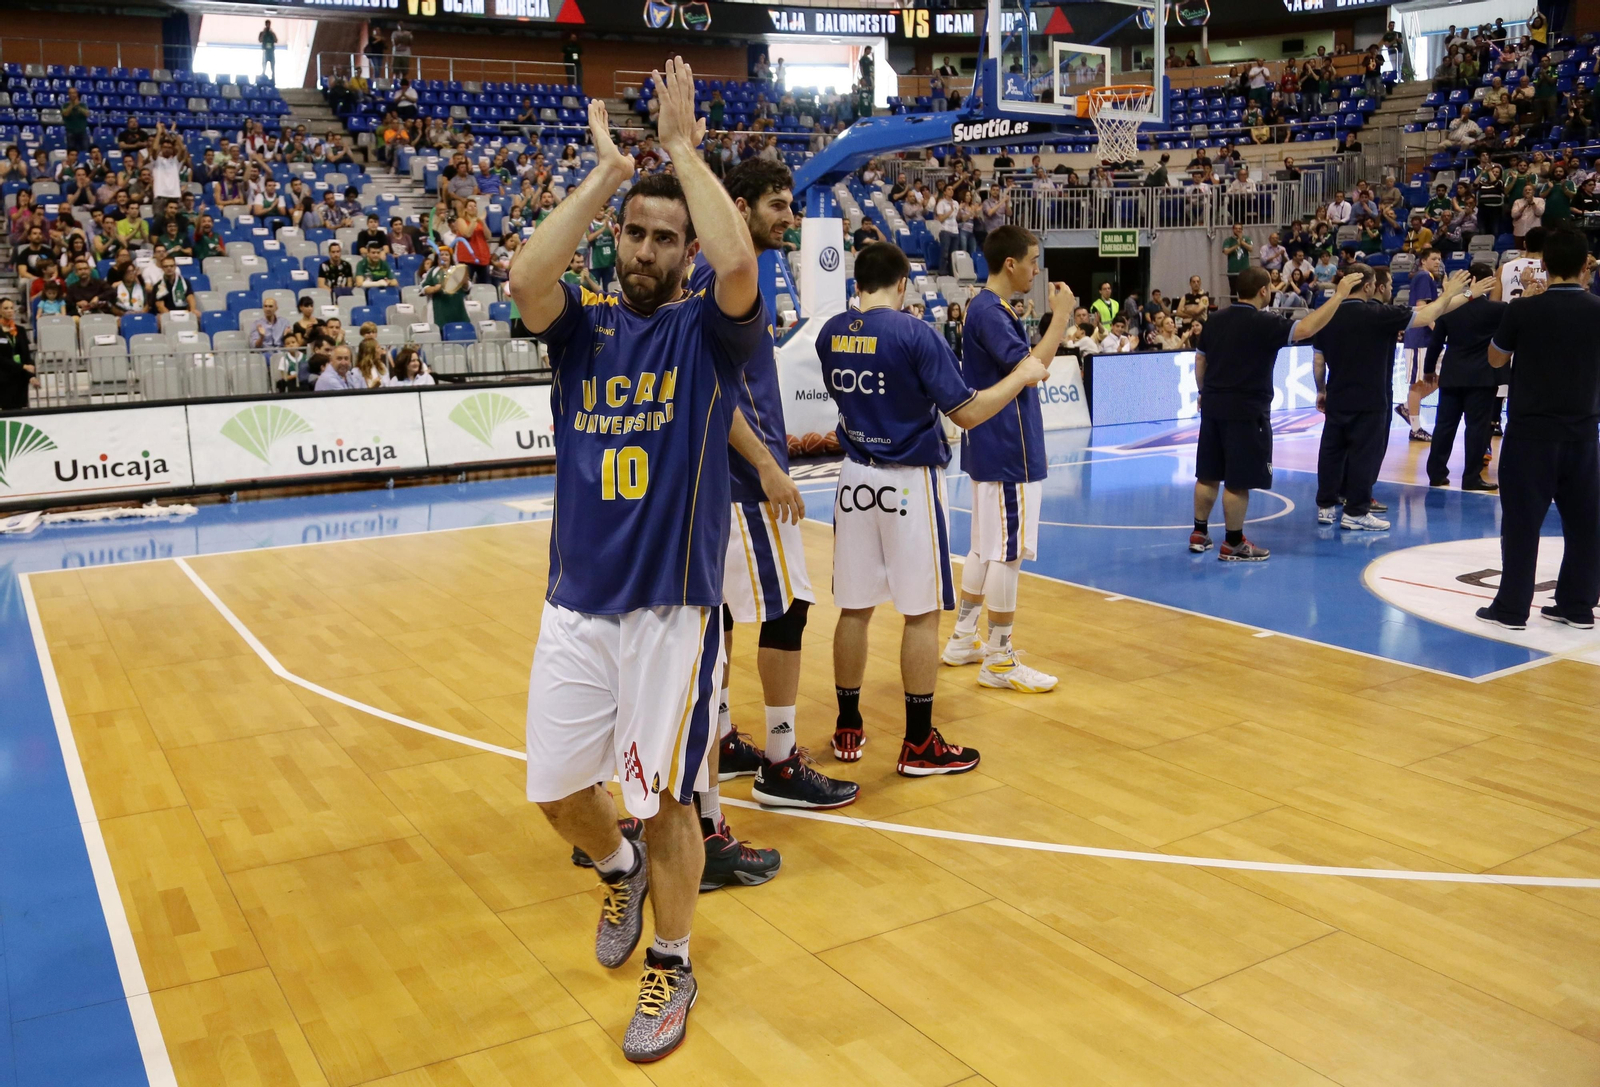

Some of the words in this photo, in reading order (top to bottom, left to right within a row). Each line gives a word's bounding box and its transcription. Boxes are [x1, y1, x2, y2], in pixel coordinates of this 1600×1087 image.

[443, 0, 485, 14] UCAM
[495, 0, 550, 18] MURCIA
[770, 11, 806, 31] CAJA
[815, 13, 897, 33] BALONCESTO
[901, 9, 930, 38] VS
[936, 13, 975, 33] UCAM
[953, 118, 1029, 143] Suertia.es
[1102, 243, 1135, 251] EMERGENCIA
[831, 335, 878, 354] MARTIN
[795, 388, 830, 402] Málag
[1038, 382, 1080, 405] desa
[297, 435, 398, 467] Unicaja
[54, 450, 170, 482] Unicaja
[601, 445, 649, 500] 10
